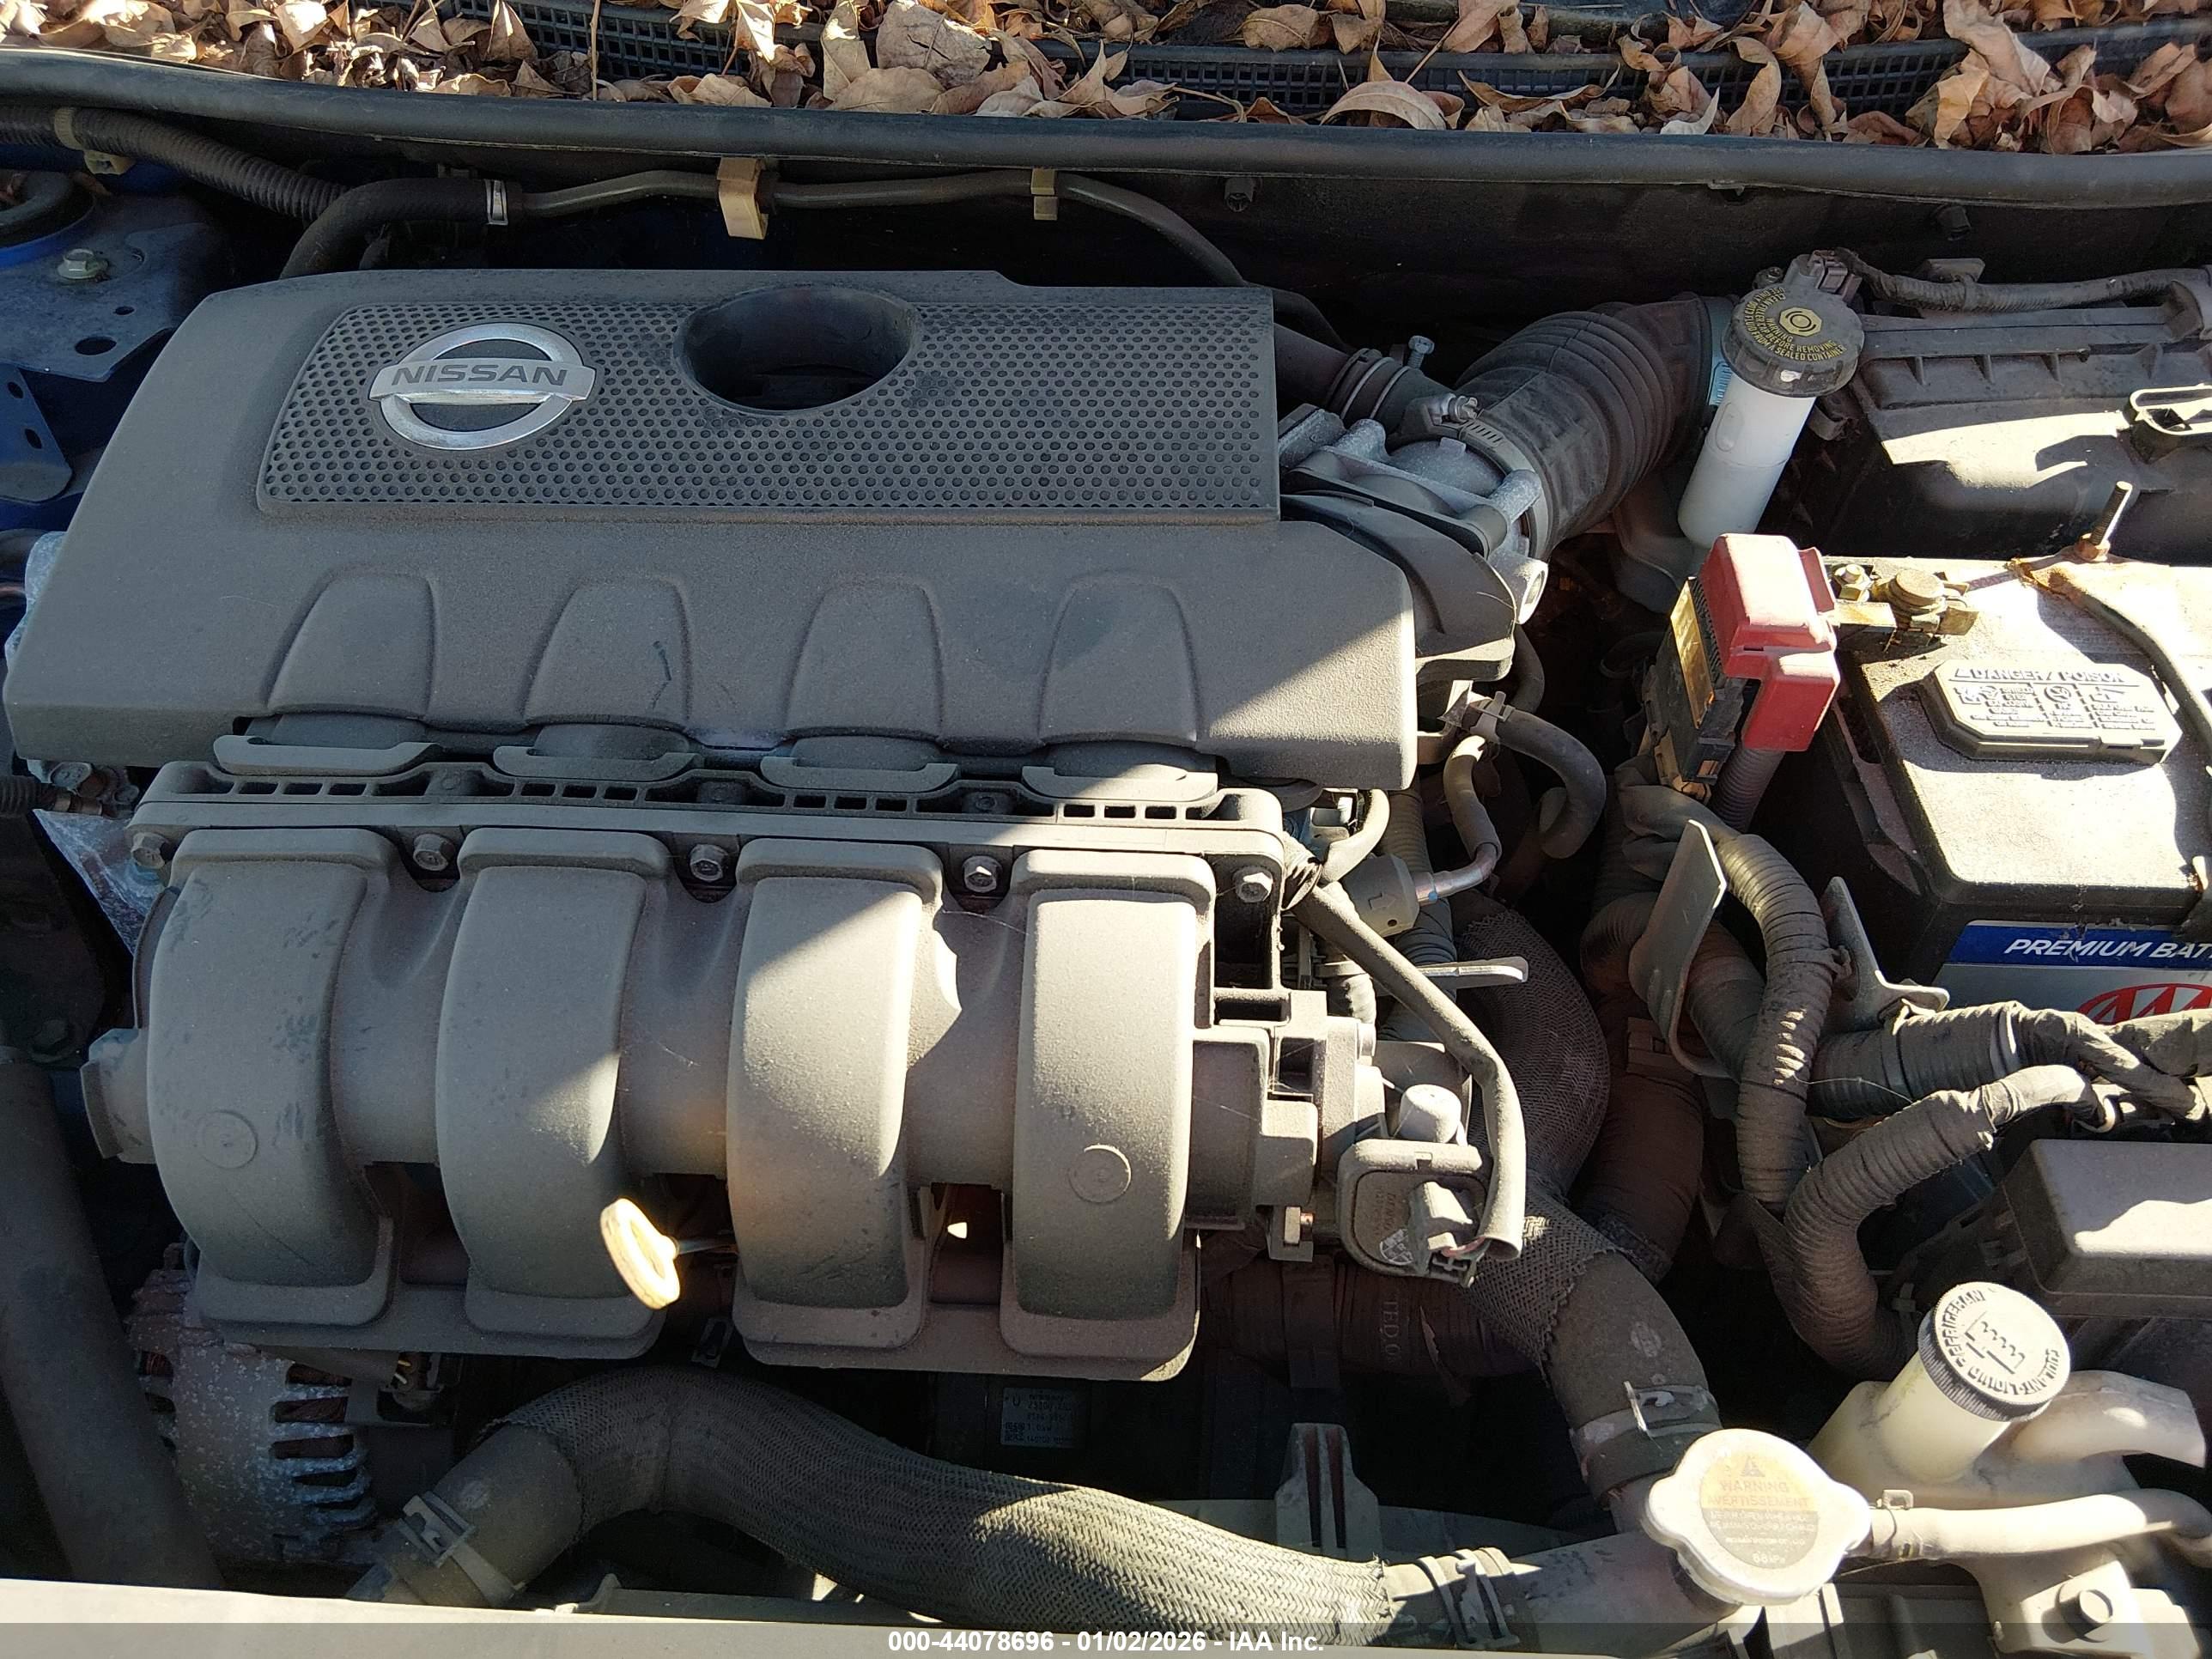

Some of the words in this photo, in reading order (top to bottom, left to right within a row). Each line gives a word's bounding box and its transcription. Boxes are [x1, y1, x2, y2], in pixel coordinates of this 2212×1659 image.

[1757, 321, 1770, 335] CAP
[1765, 332, 1795, 350] BEFORE
[1796, 340, 1837, 353] REMOVING
[1765, 318, 1793, 343] WARNING
[1752, 330, 1771, 347] FROM
[1775, 347, 1806, 361] SEALED
[1808, 344, 1847, 361] CONTAINER
[392, 364, 568, 386] NISSAN
[1971, 669, 2042, 680] DANGER
[2060, 672, 2124, 683] POISON
[2004, 939, 2153, 958] PREMIUM
[2149, 942, 2212, 959] BAT
[1719, 1480, 1789, 1493] WARNING
[1709, 1495, 1808, 1506] AVERTISSEMENT
